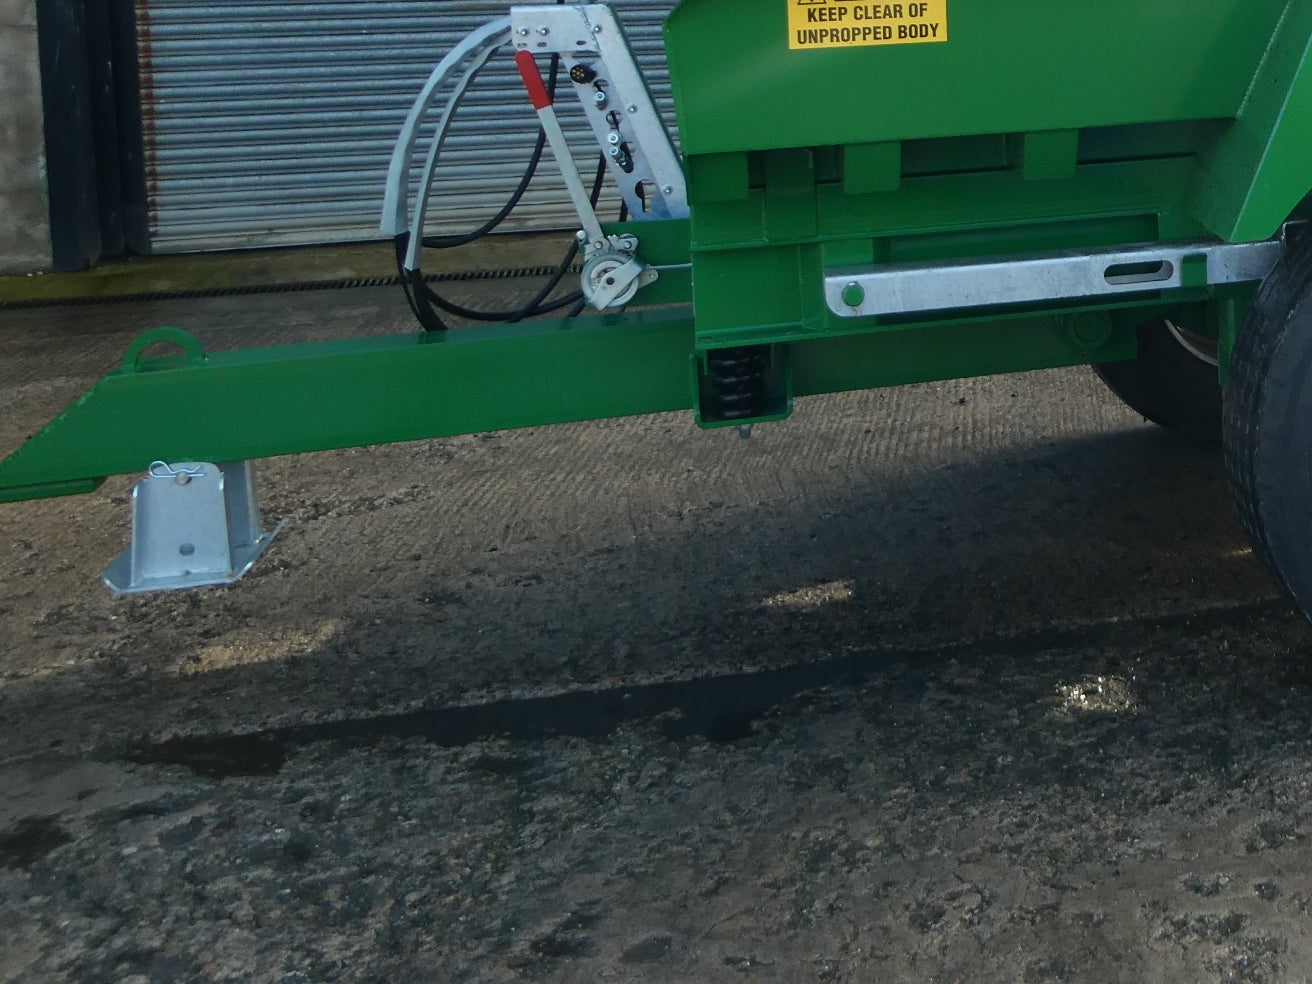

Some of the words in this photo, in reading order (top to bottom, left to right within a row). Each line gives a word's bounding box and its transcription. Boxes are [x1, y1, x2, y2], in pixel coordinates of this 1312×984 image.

[807, 6, 848, 22] KEEP
[853, 3, 904, 21] CLEAR
[908, 2, 928, 18] OF
[797, 25, 892, 45] UNPROPPED
[898, 22, 939, 39] BODY
